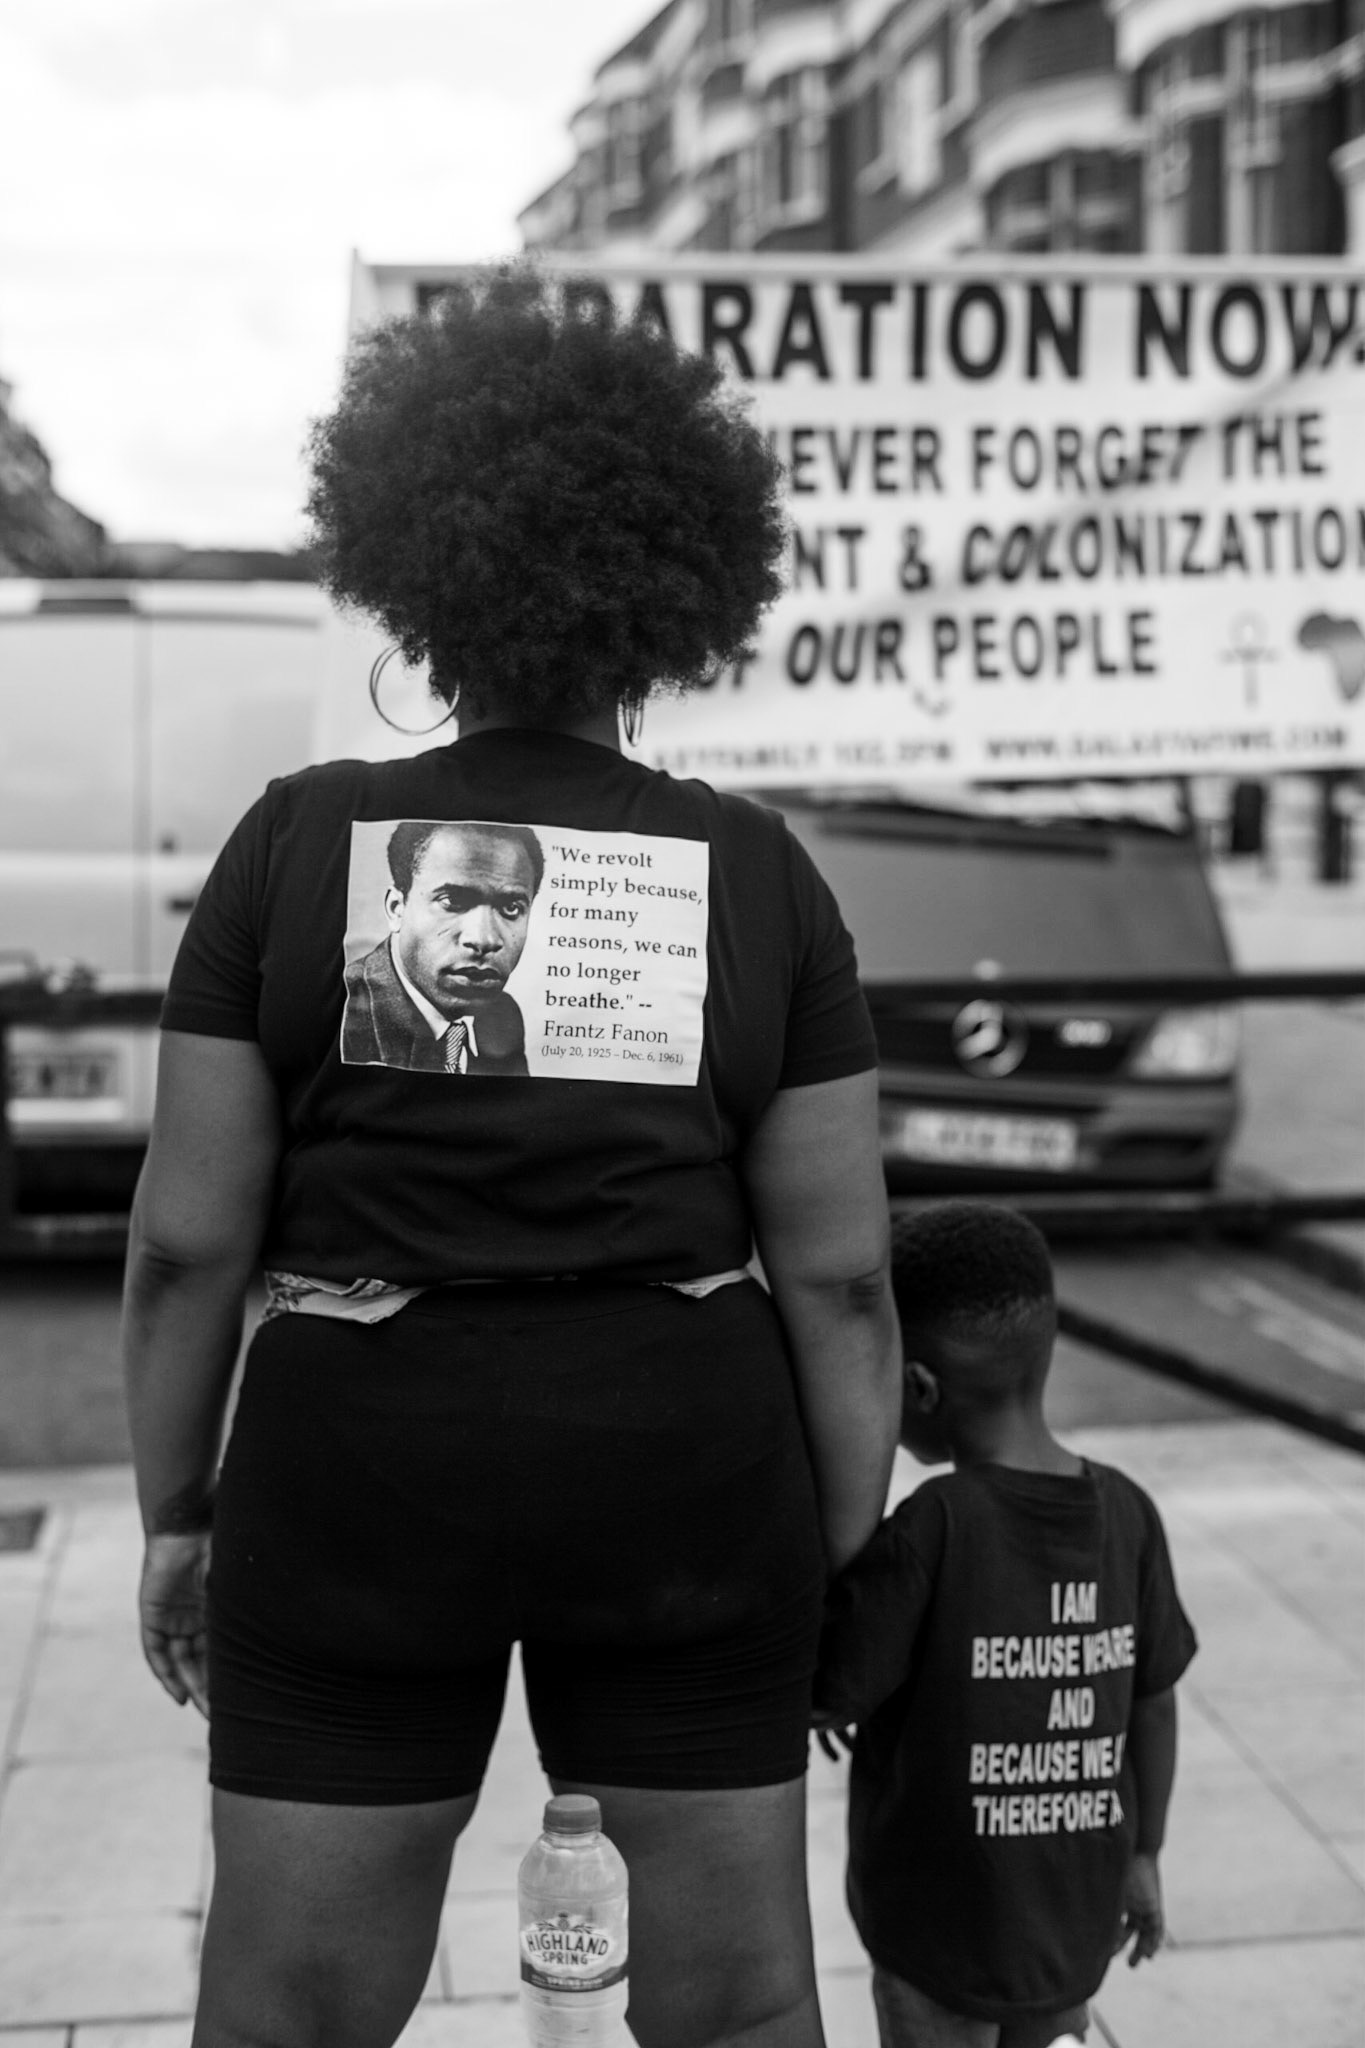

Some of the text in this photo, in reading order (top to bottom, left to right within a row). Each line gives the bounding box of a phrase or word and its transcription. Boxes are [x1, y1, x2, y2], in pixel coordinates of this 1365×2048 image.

[766, 412, 1325, 493] EVER FORGET THE
[900, 526, 934, 593] &
[960, 507, 1365, 585] COLONIZATIO
[785, 618, 904, 687] OUR
[932, 610, 1157, 681] PEOPLE
[552, 845, 653, 868] "We revolt
[550, 873, 702, 905] simply because,
[550, 901, 639, 928] for many
[549, 935, 698, 958] reasons, we can
[547, 962, 641, 985] no longer
[545, 990, 633, 1010] breathe."
[544, 1020, 669, 1044] Frantz Fanon
[541, 1045, 567, 1058] (July
[569, 1046, 584, 1058] 20,
[588, 1047, 611, 1058] 1925
[622, 1049, 645, 1061] Dec.
[647, 1053, 656, 1063] 6,
[658, 1052, 684, 1066] 1961)
[1051, 1581, 1097, 1624] I AM
[971, 1634, 1081, 1679] BECAUSE
[1047, 1686, 1095, 1730] AND
[969, 1738, 1081, 1785] BECAUSE
[1081, 1736, 1114, 1780] WE
[972, 1789, 1110, 1836] THEREFORE
[525, 1932, 609, 1956] HIGHLAND
[542, 1951, 588, 1966] SPRING
